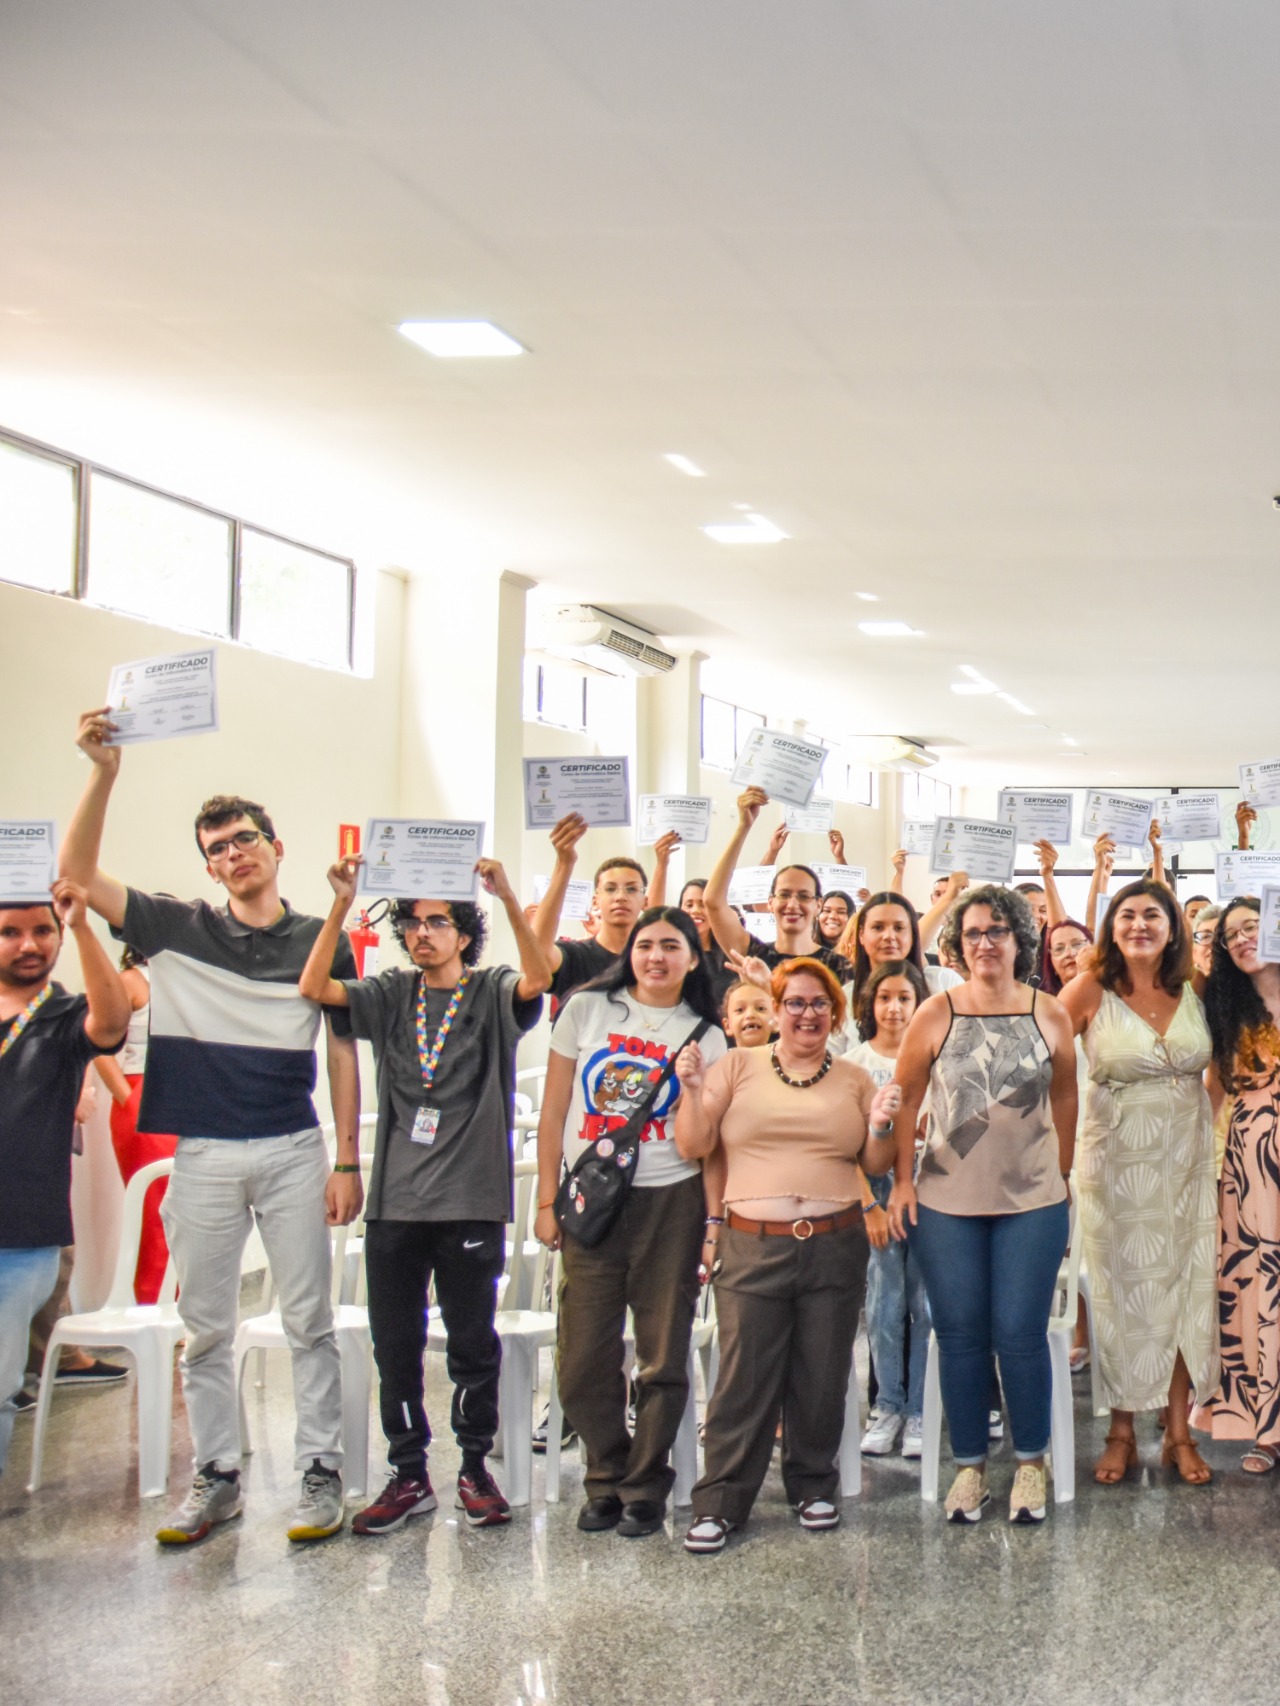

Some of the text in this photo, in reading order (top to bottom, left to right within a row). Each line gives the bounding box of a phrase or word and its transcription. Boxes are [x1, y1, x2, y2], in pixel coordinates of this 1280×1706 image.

[145, 657, 208, 674] CERTIFICADO
[772, 738, 822, 759] CERTIFICADO
[561, 764, 621, 772] CERTIFICADO
[663, 799, 706, 807] CERTIFICADO
[1023, 797, 1067, 805] CERTIFICADO
[1107, 798, 1148, 811] CERTIFICADO
[1177, 797, 1215, 805] CERTIFICADO
[408, 827, 475, 838] CERTIFICADO
[964, 824, 1012, 836] CERTIFICADO
[830, 868, 862, 876] CERTIFICADO
[607, 1033, 667, 1062] TOM
